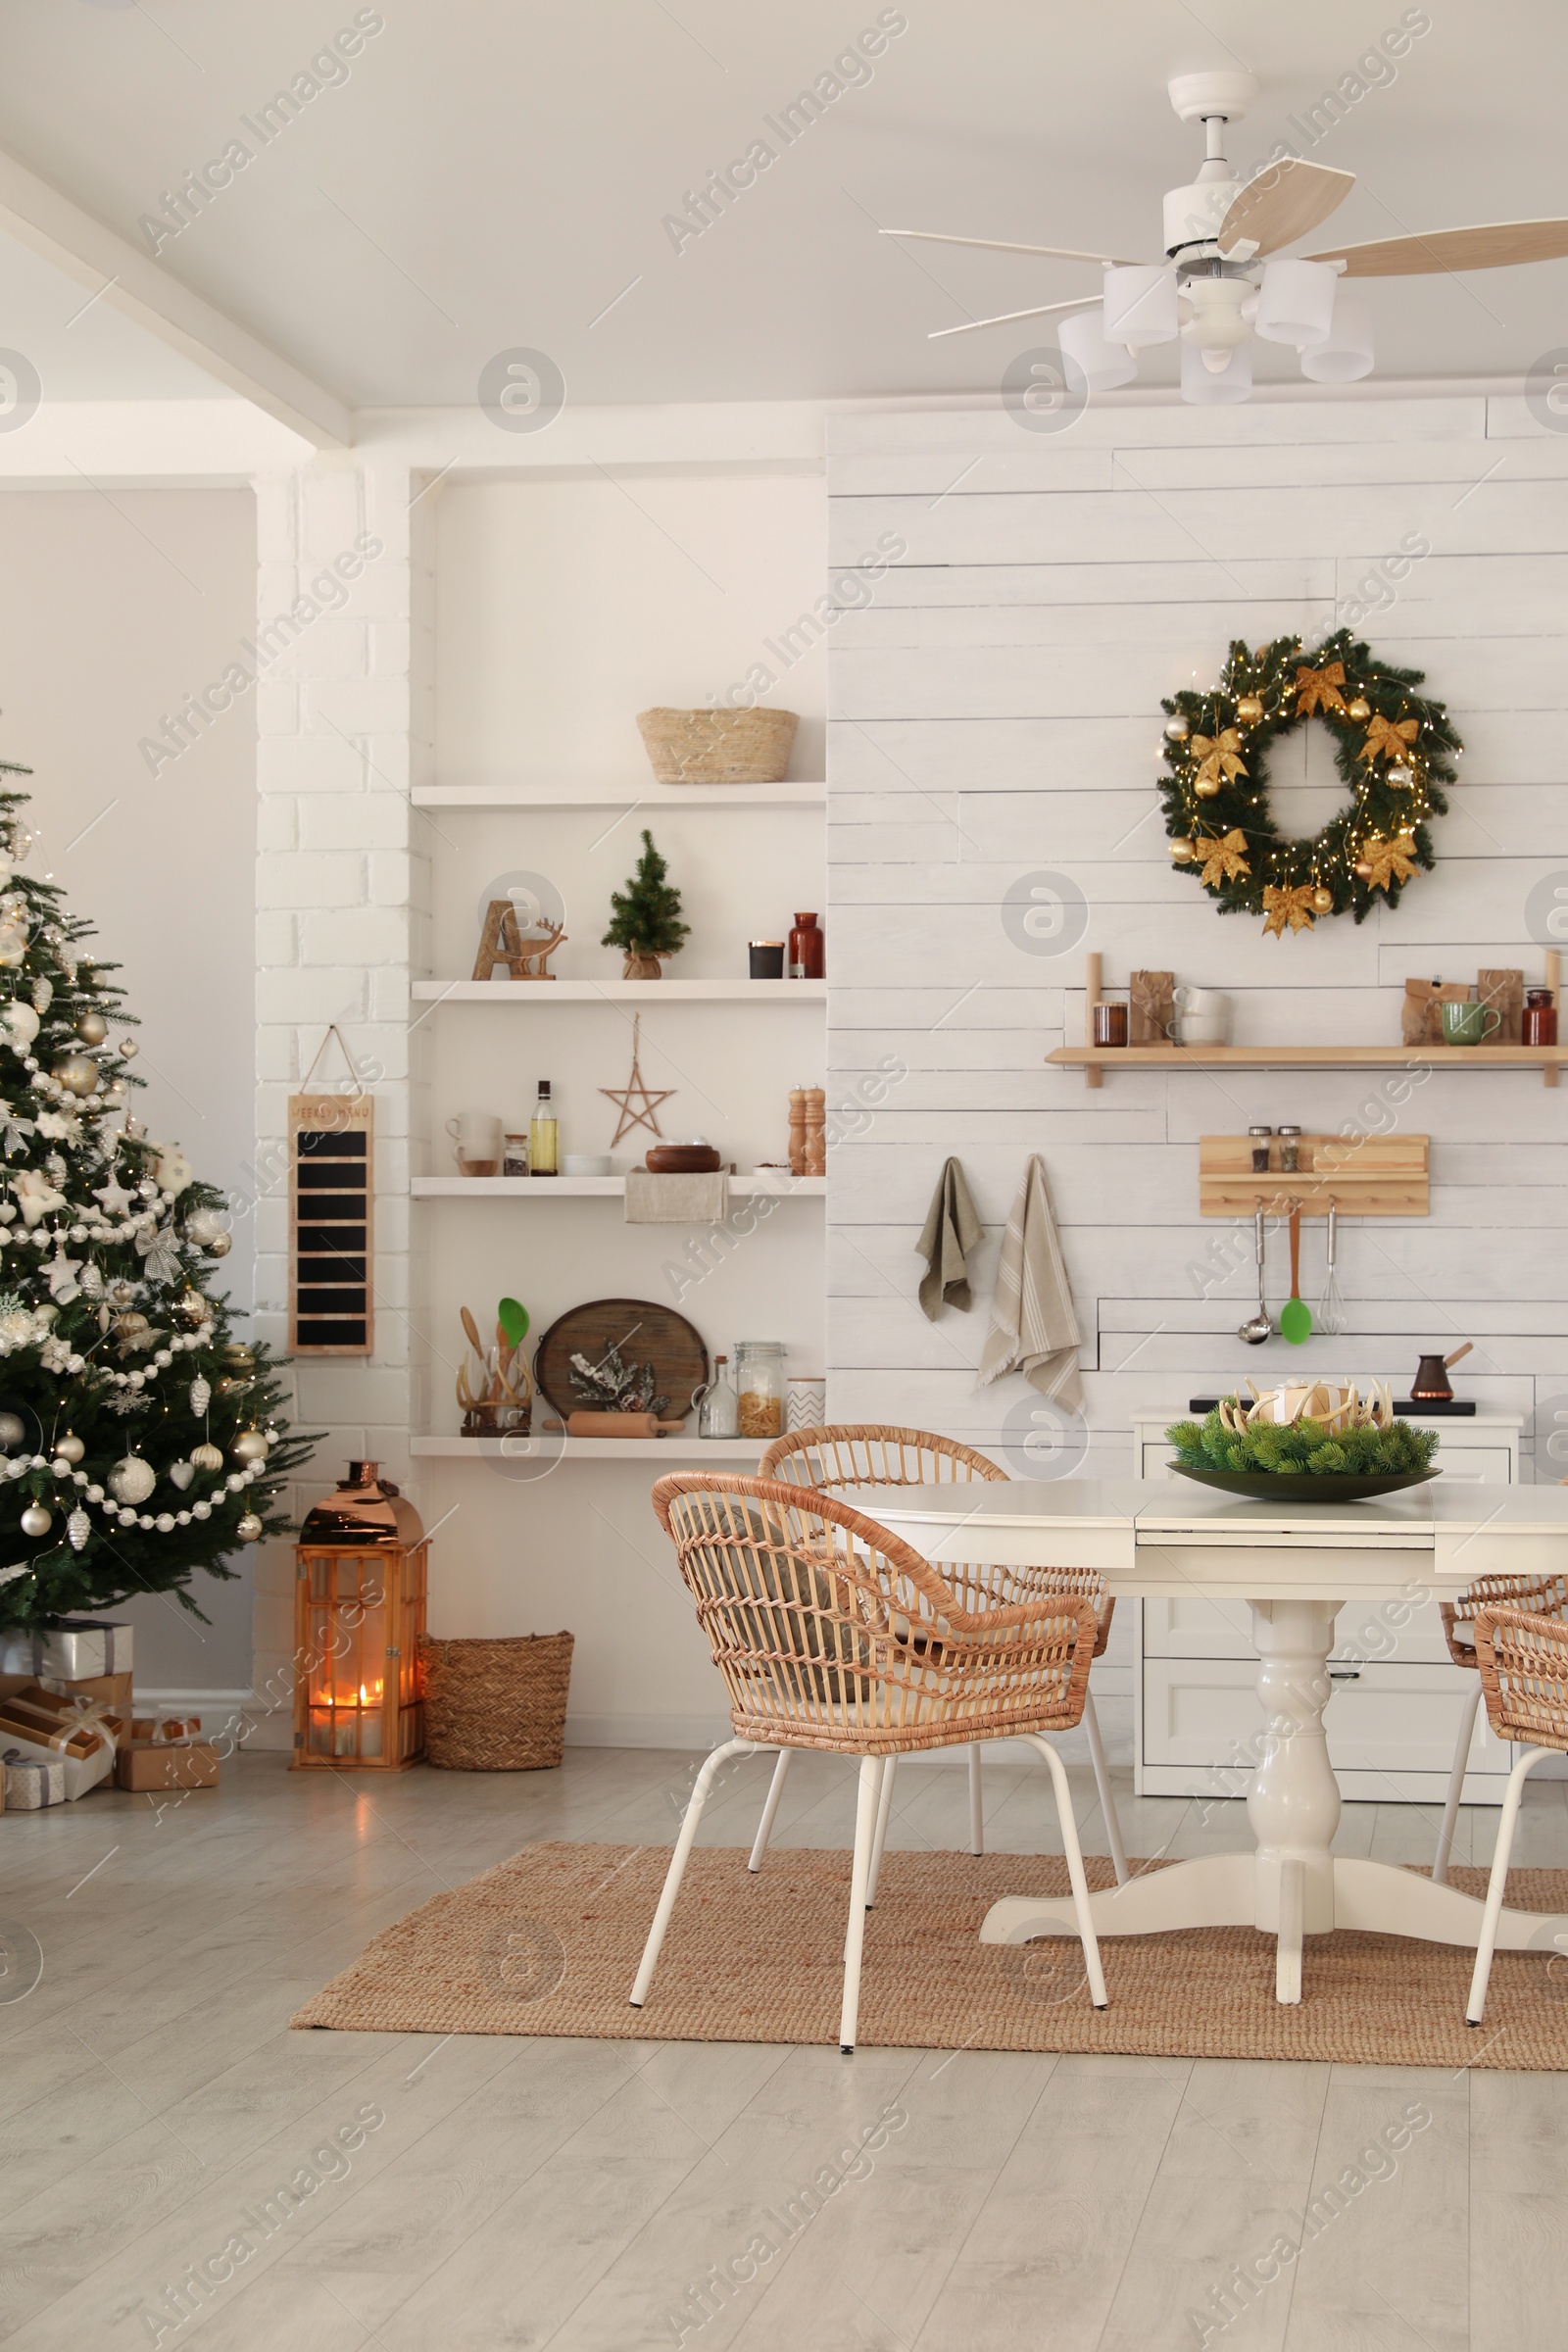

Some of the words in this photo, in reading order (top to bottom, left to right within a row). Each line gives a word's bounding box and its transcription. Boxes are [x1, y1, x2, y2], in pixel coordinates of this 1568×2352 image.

[471, 900, 521, 981] A
[291, 1107, 331, 1118] WEEKLY
[338, 1107, 368, 1117] MENU
